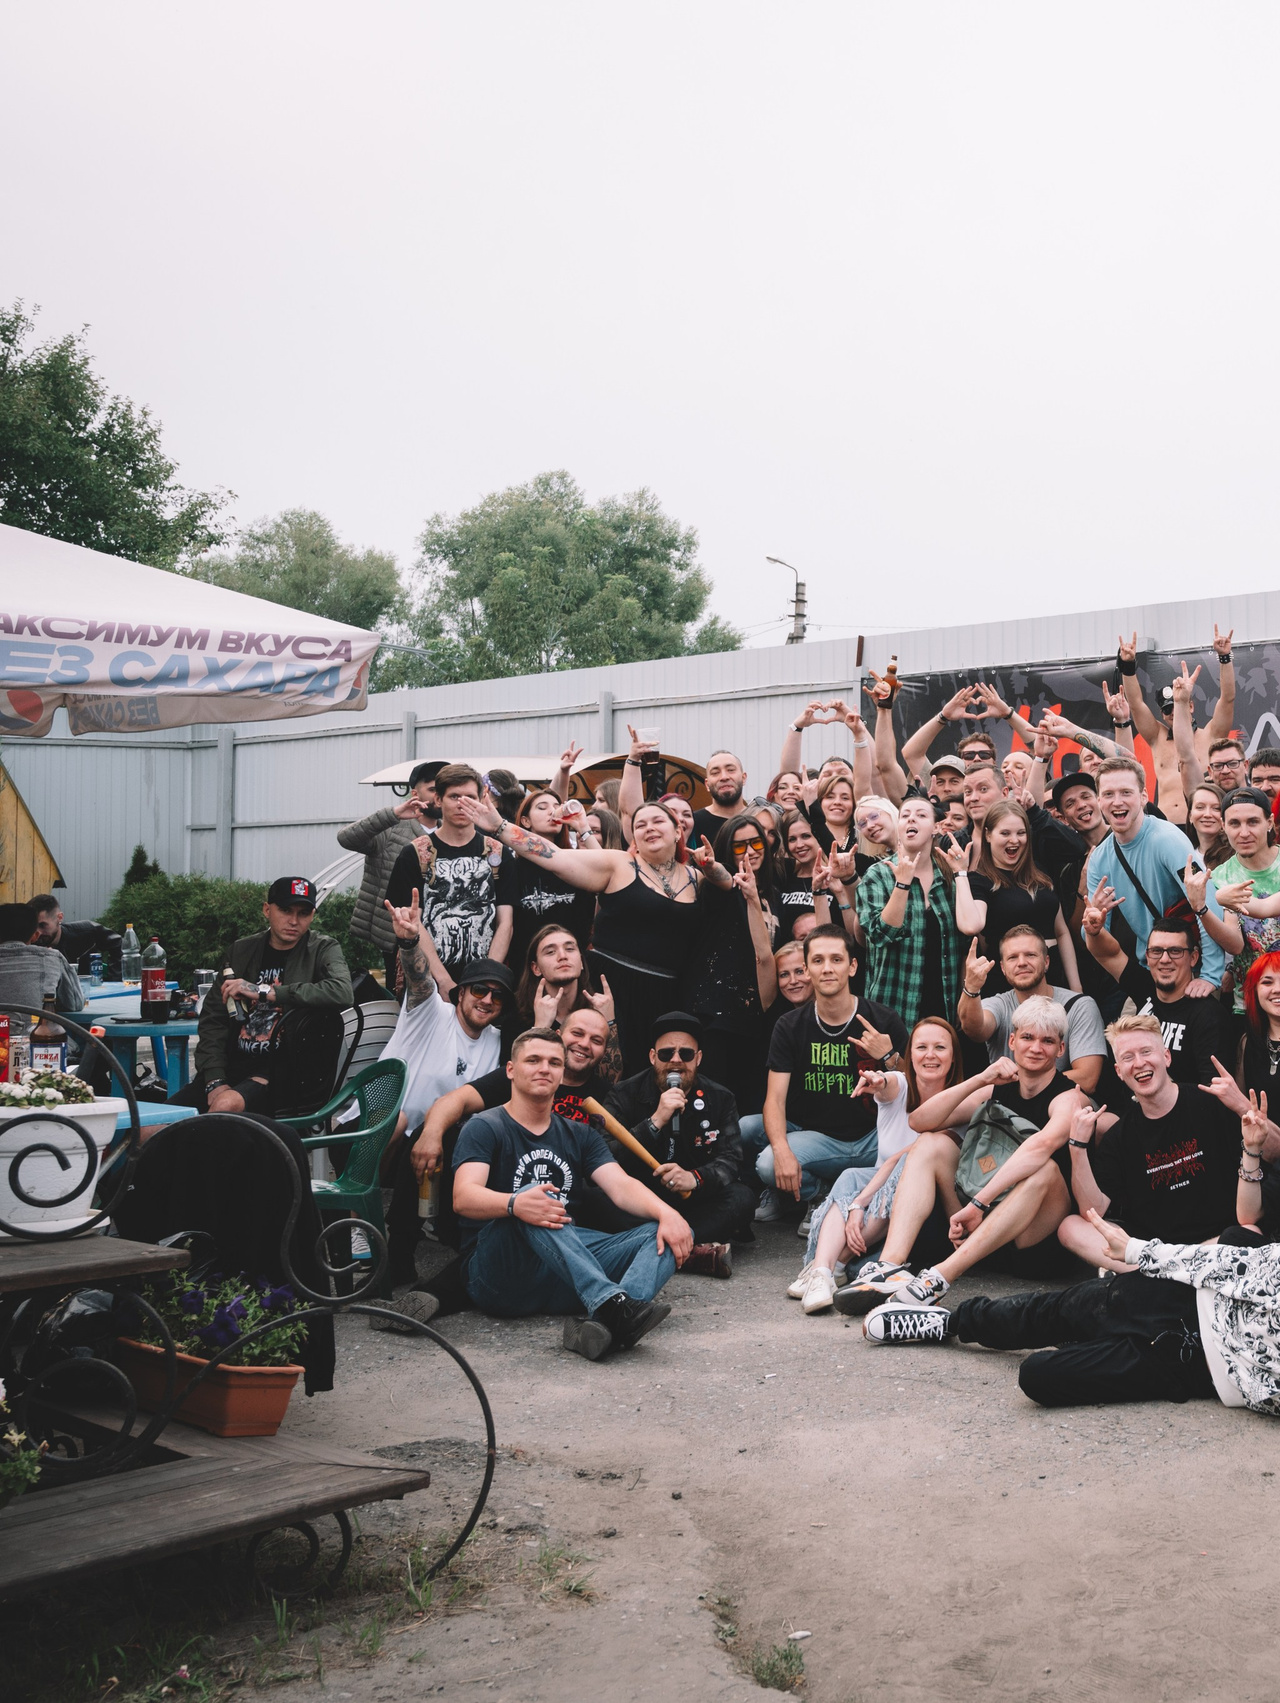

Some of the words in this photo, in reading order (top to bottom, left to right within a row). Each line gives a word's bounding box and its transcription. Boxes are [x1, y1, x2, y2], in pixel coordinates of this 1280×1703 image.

[217, 630, 353, 662] ВКУСА
[109, 650, 342, 699] САХАРА
[256, 968, 284, 985] SAIN
[522, 1153, 532, 1165] IN
[530, 1148, 554, 1160] ORDER
[553, 1154, 562, 1166] TO
[560, 1161, 573, 1192] IMAGINE
[1191, 1150, 1203, 1158] LOVE
